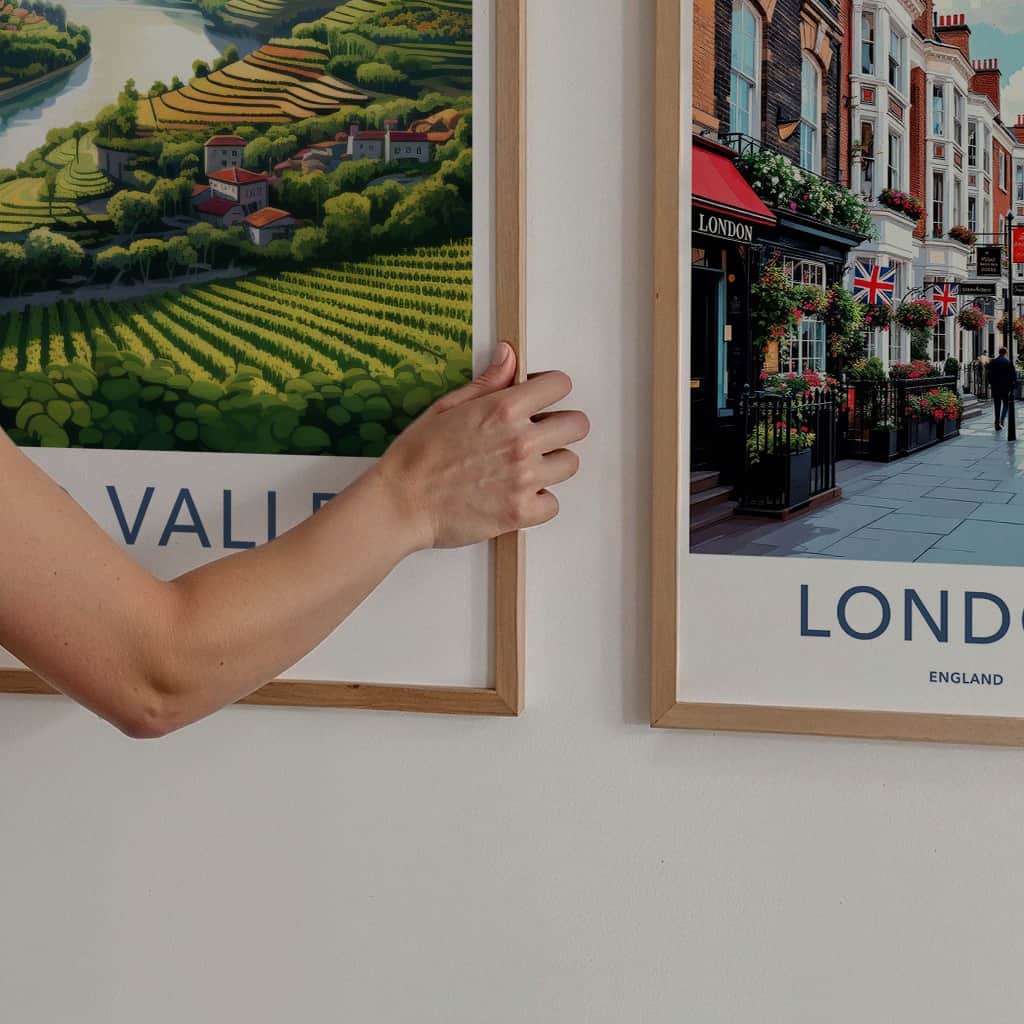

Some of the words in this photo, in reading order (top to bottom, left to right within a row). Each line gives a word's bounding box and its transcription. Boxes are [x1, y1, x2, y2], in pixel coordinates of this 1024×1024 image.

[699, 213, 753, 242] LONDON
[105, 485, 338, 549] VALL
[800, 583, 1024, 645] LOND
[928, 671, 1004, 686] ENGLAND
